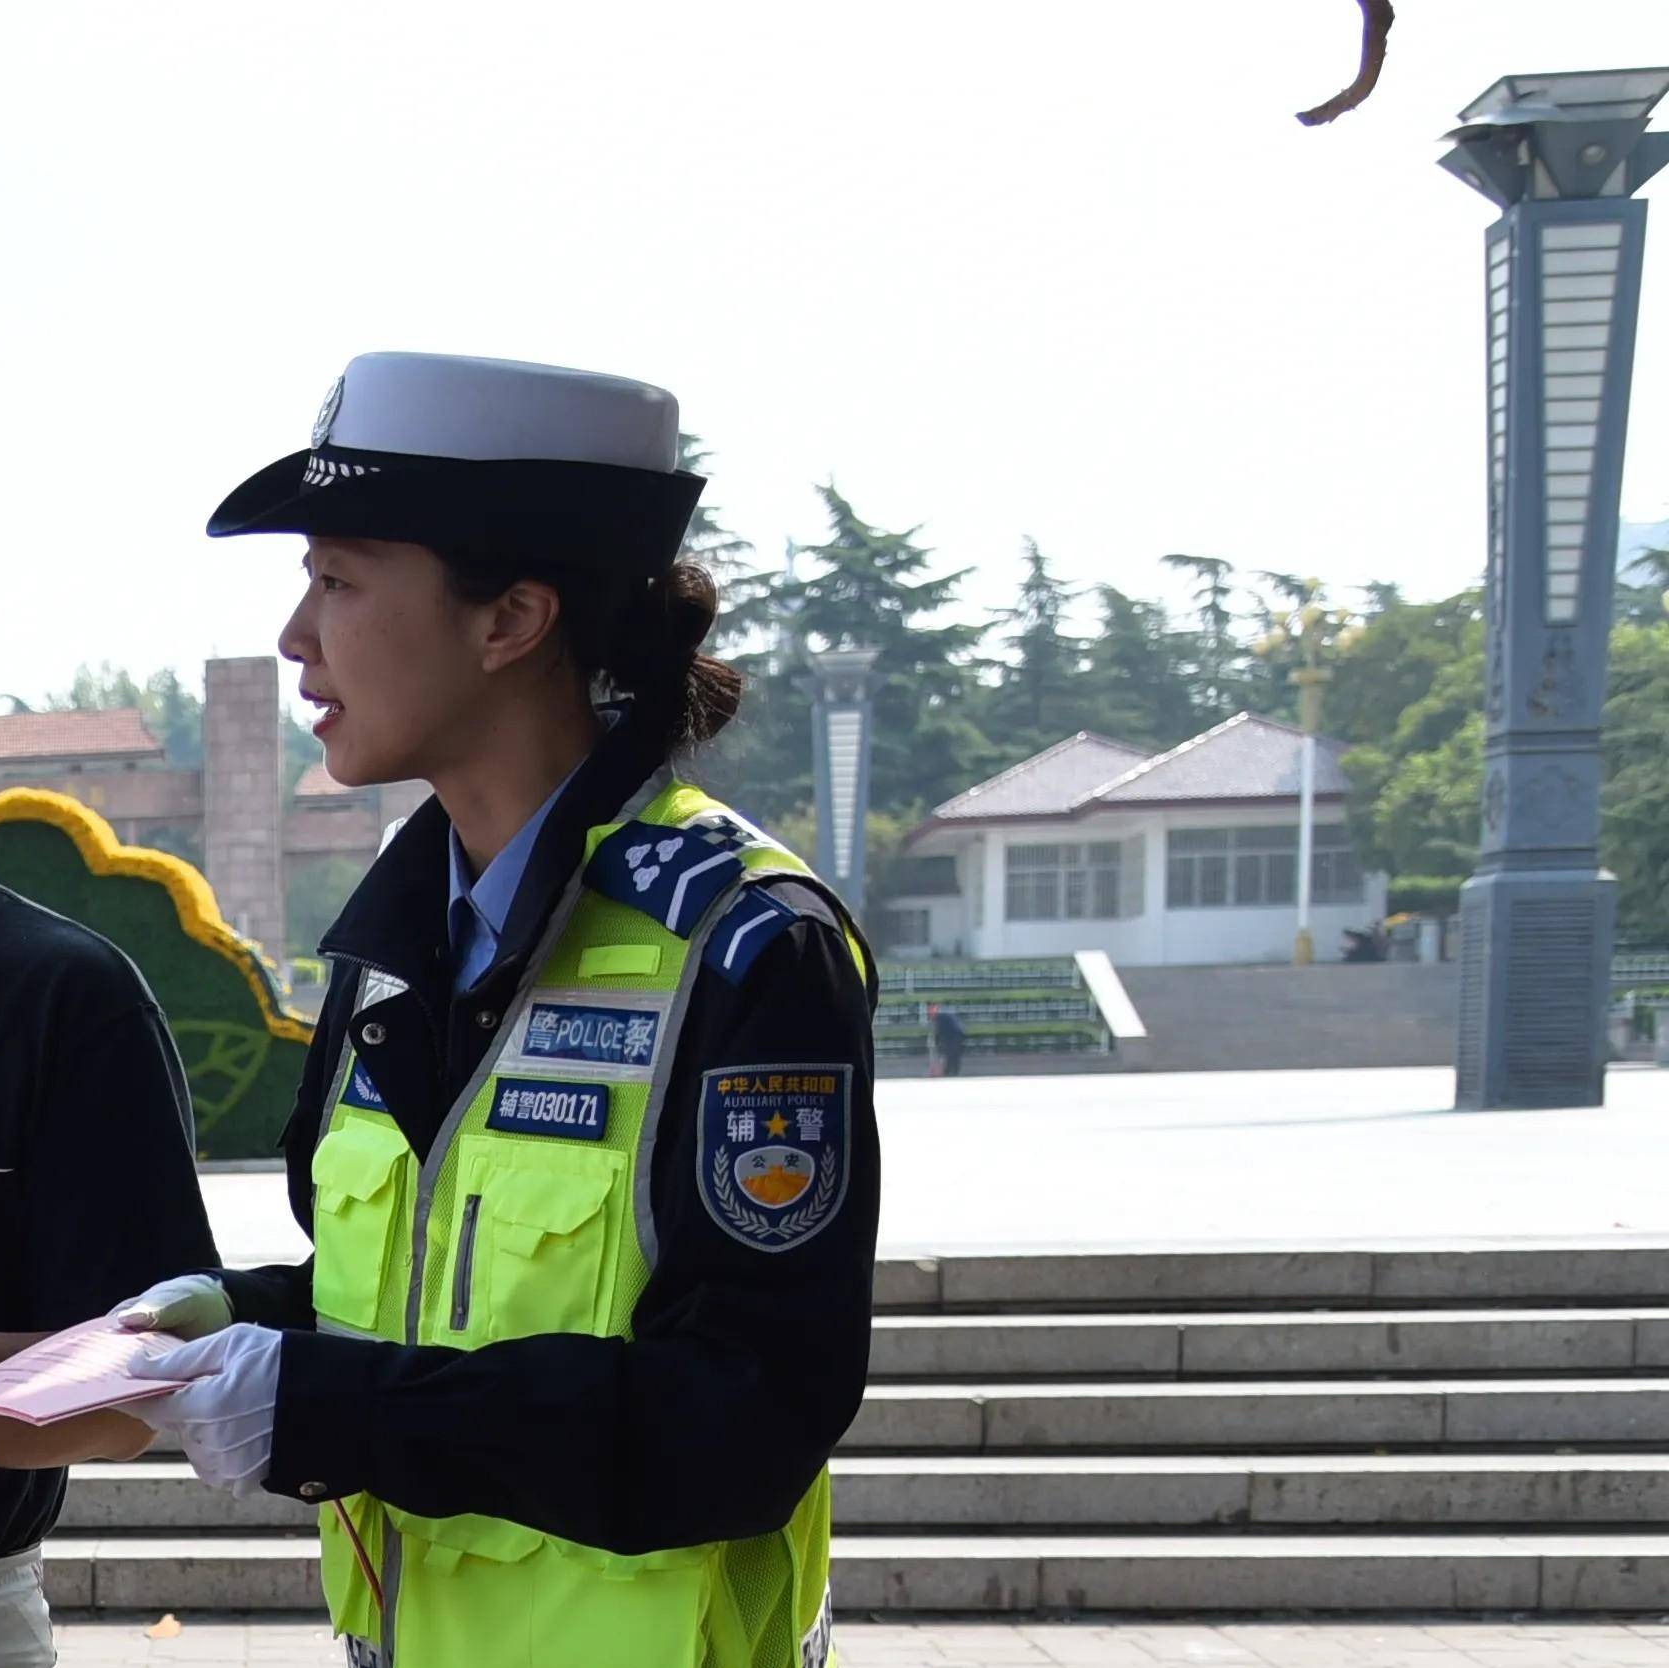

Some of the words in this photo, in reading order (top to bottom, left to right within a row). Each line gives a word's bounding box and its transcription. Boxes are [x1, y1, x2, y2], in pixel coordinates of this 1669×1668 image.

[717, 1075, 835, 1095] 中华人民共和国
[724, 1095, 782, 1108] AUXILIARY
[787, 1094, 826, 1106] POLICE
